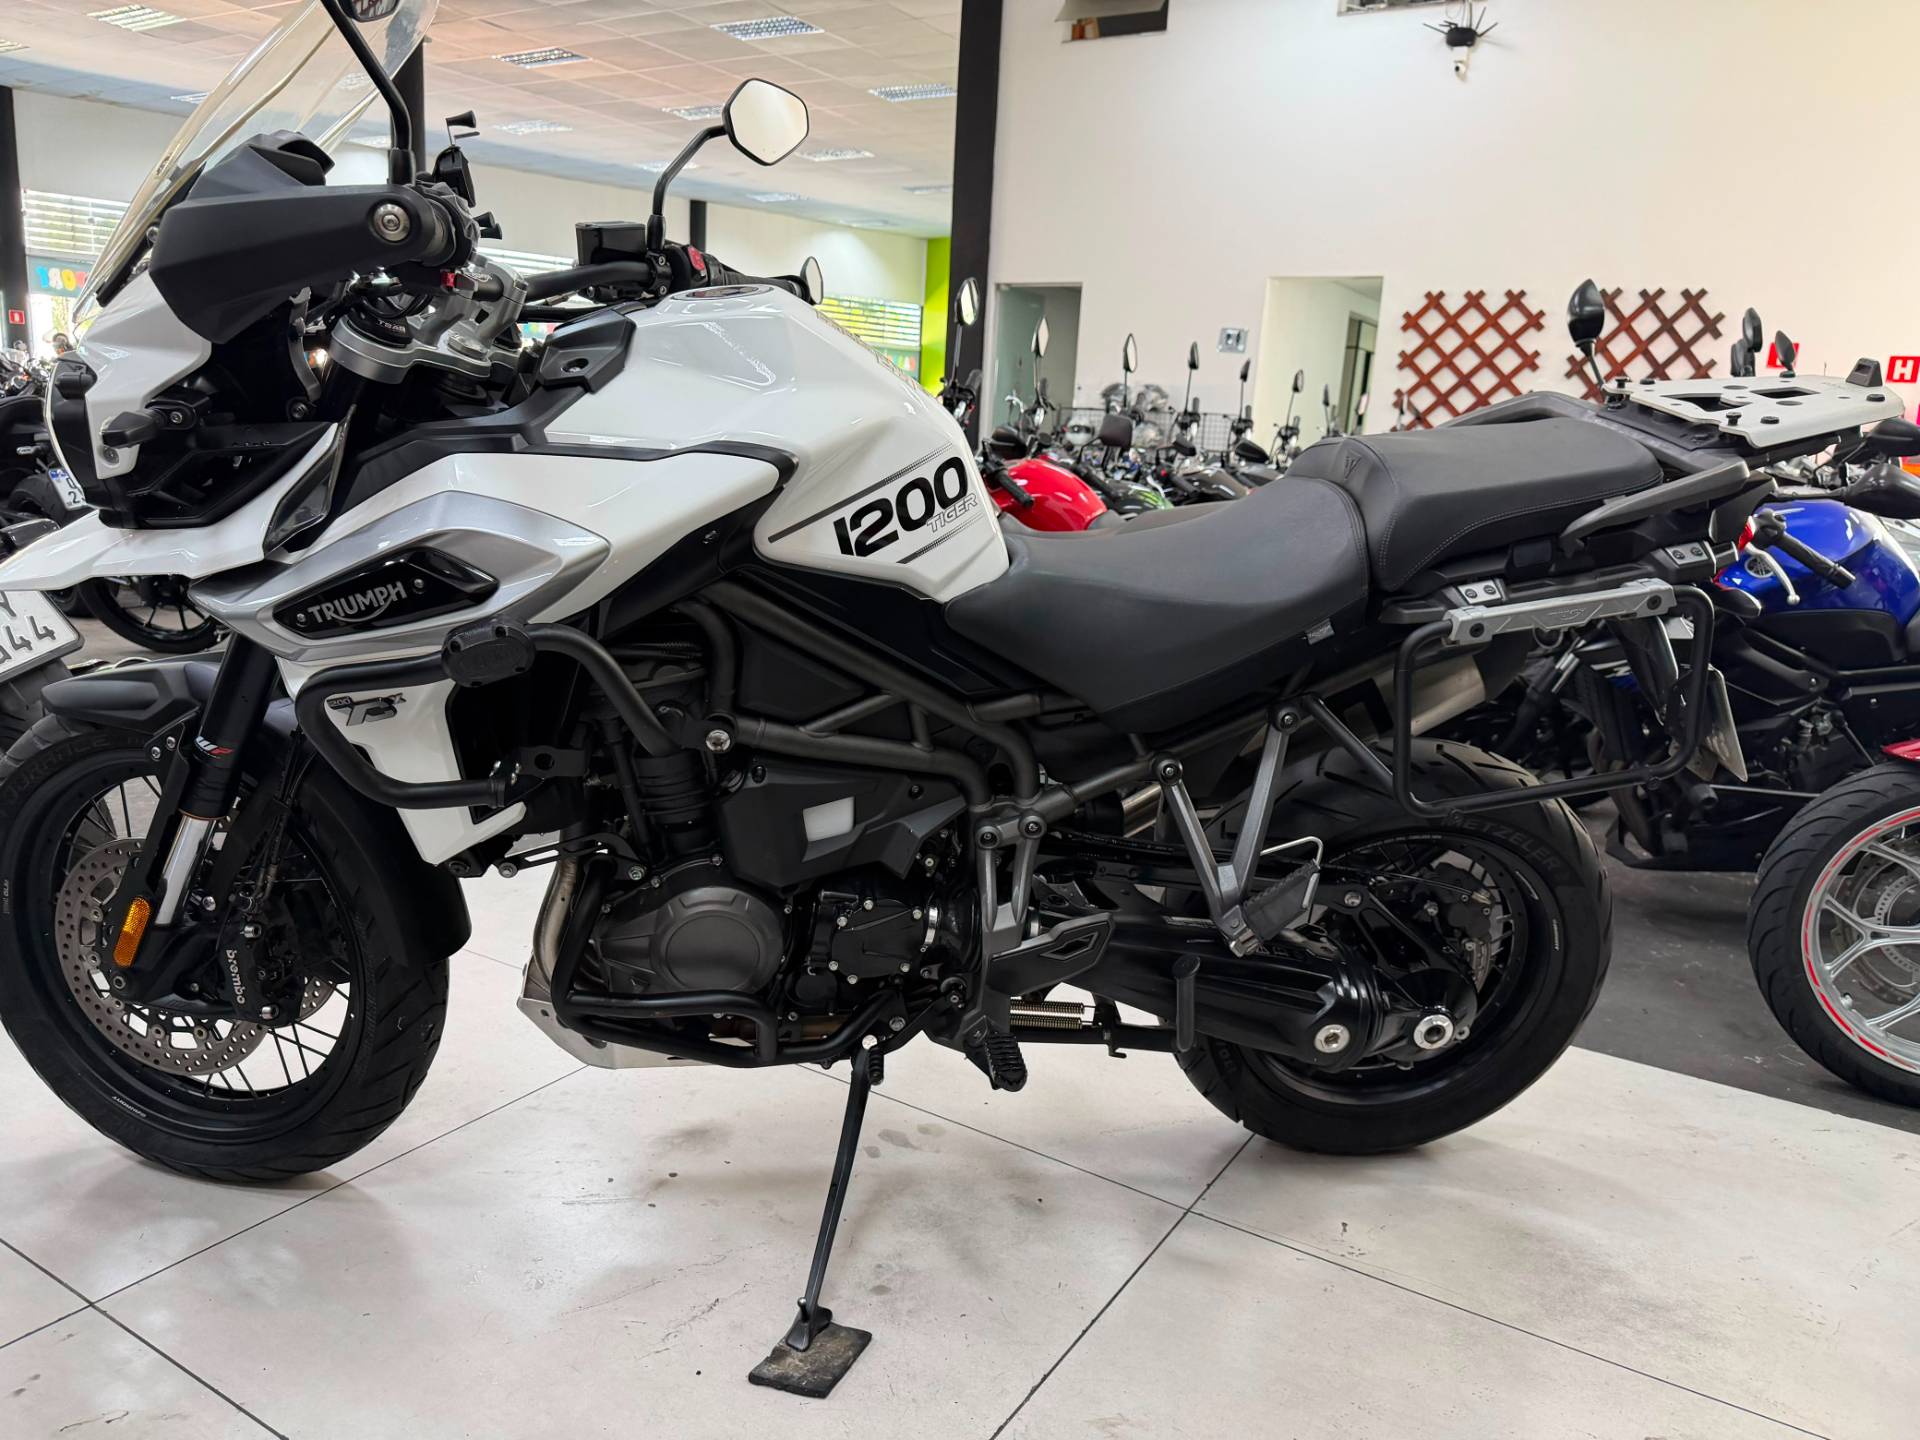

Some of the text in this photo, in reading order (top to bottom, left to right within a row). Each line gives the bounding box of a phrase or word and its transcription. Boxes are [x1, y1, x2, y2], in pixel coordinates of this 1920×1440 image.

[833, 456, 968, 557] 1200
[926, 493, 978, 532] TIGER
[307, 581, 408, 624] TRIUMPH
[226, 949, 246, 1005] brembo
